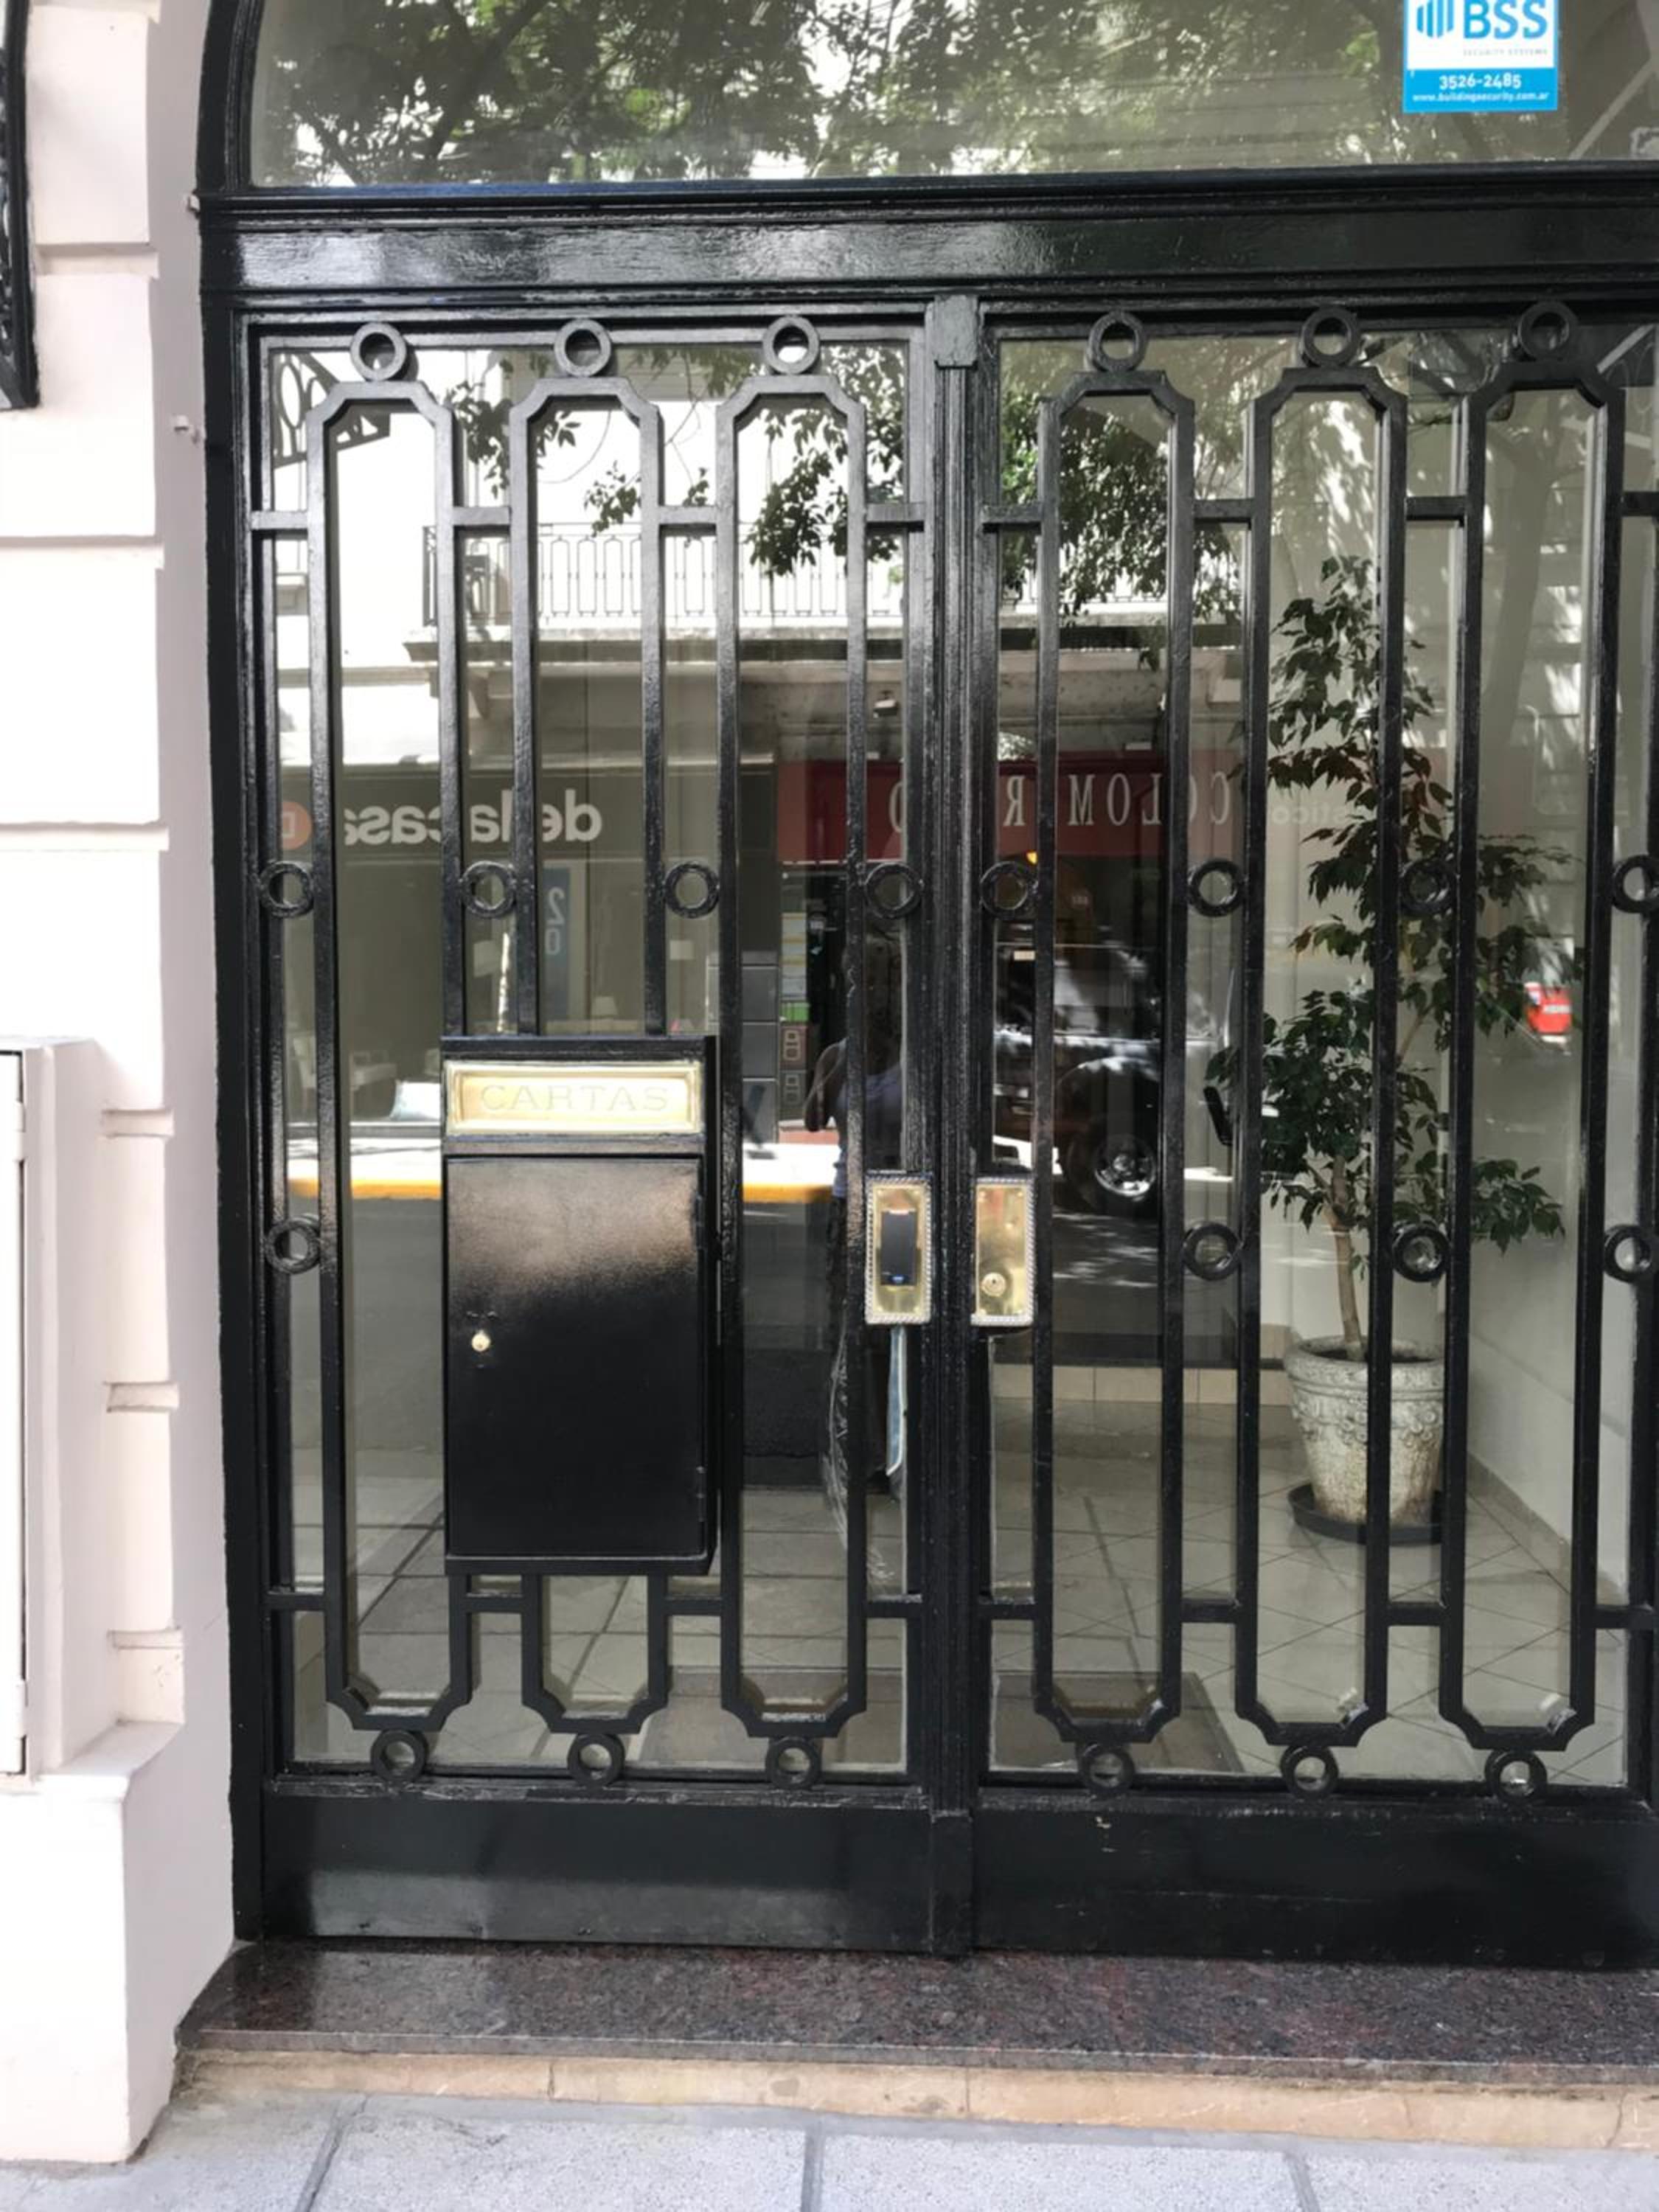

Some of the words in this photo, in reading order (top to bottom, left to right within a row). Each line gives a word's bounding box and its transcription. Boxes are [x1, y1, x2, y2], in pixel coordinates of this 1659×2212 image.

[1464, 0, 1548, 39] BSS
[1439, 72, 1522, 90] 3526-2485
[481, 1085, 668, 1112] CARTAS
